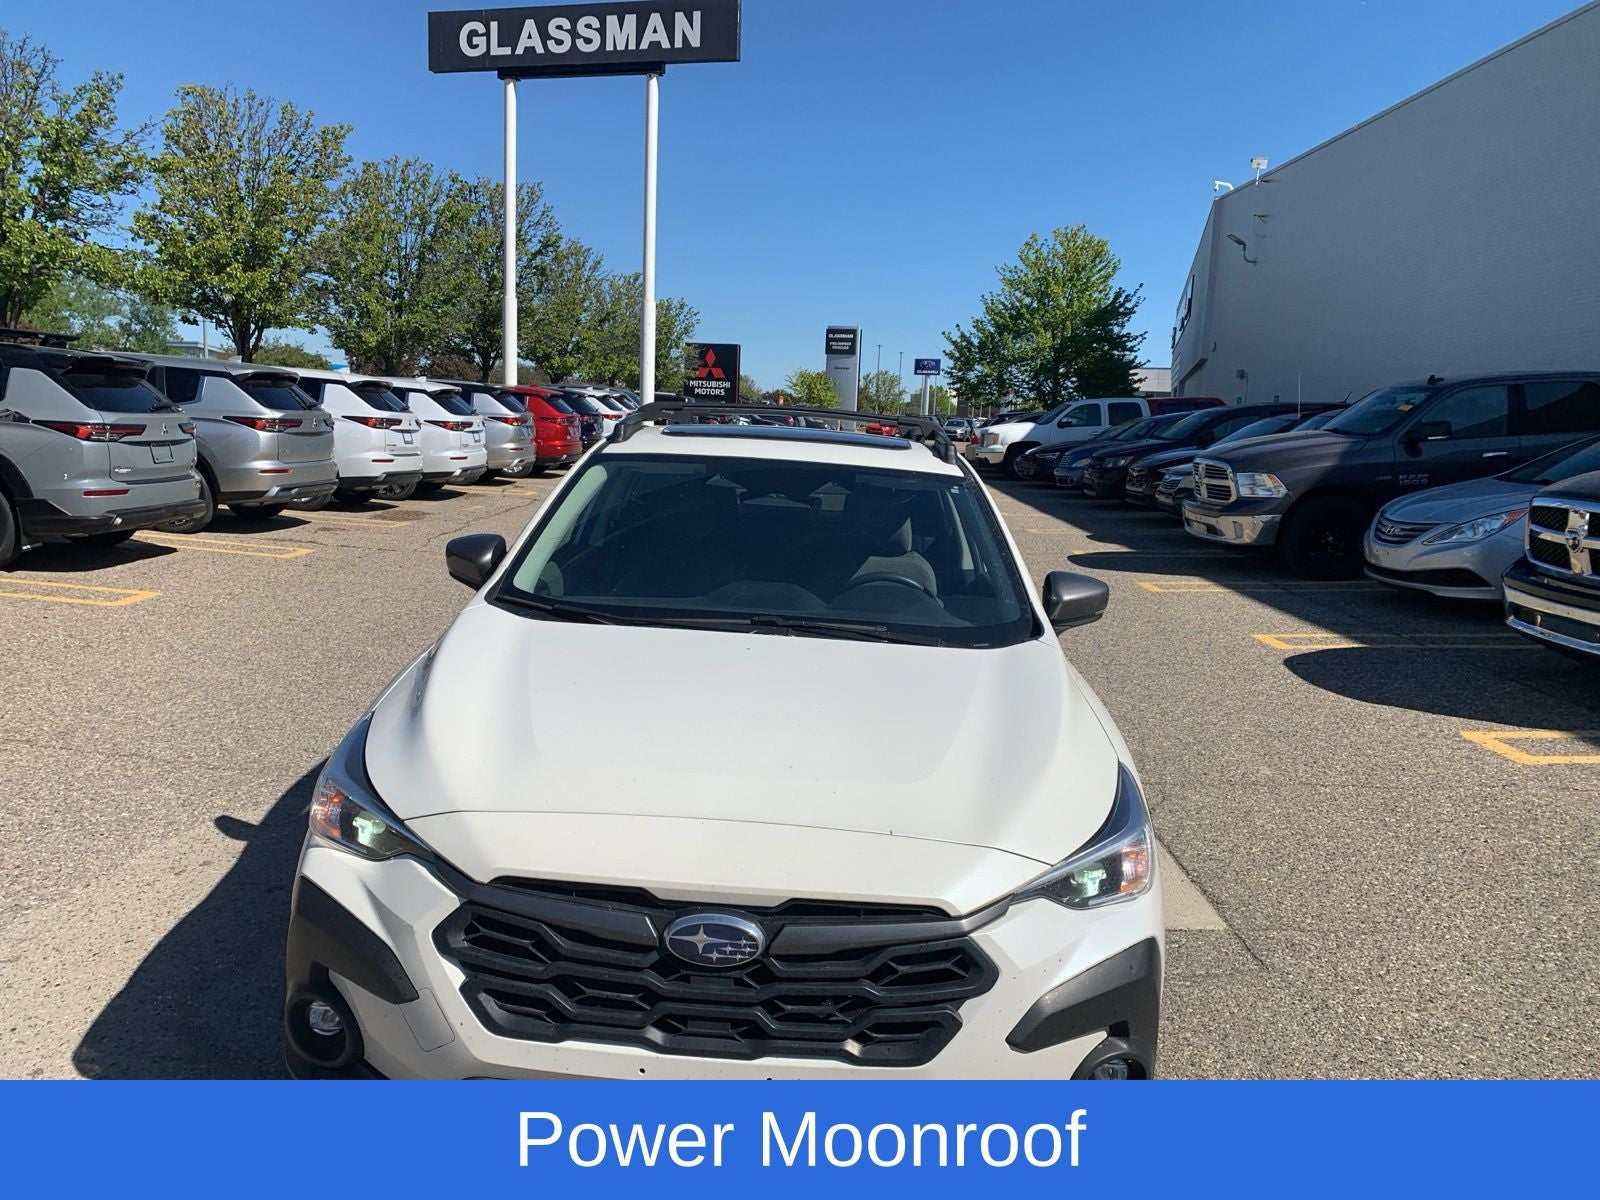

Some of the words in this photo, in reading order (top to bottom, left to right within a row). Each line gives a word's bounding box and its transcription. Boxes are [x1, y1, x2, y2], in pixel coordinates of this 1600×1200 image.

[459, 10, 701, 57] GLASSMAN
[689, 380, 731, 388] MITSUBISHI
[694, 388, 726, 396] MOTORS
